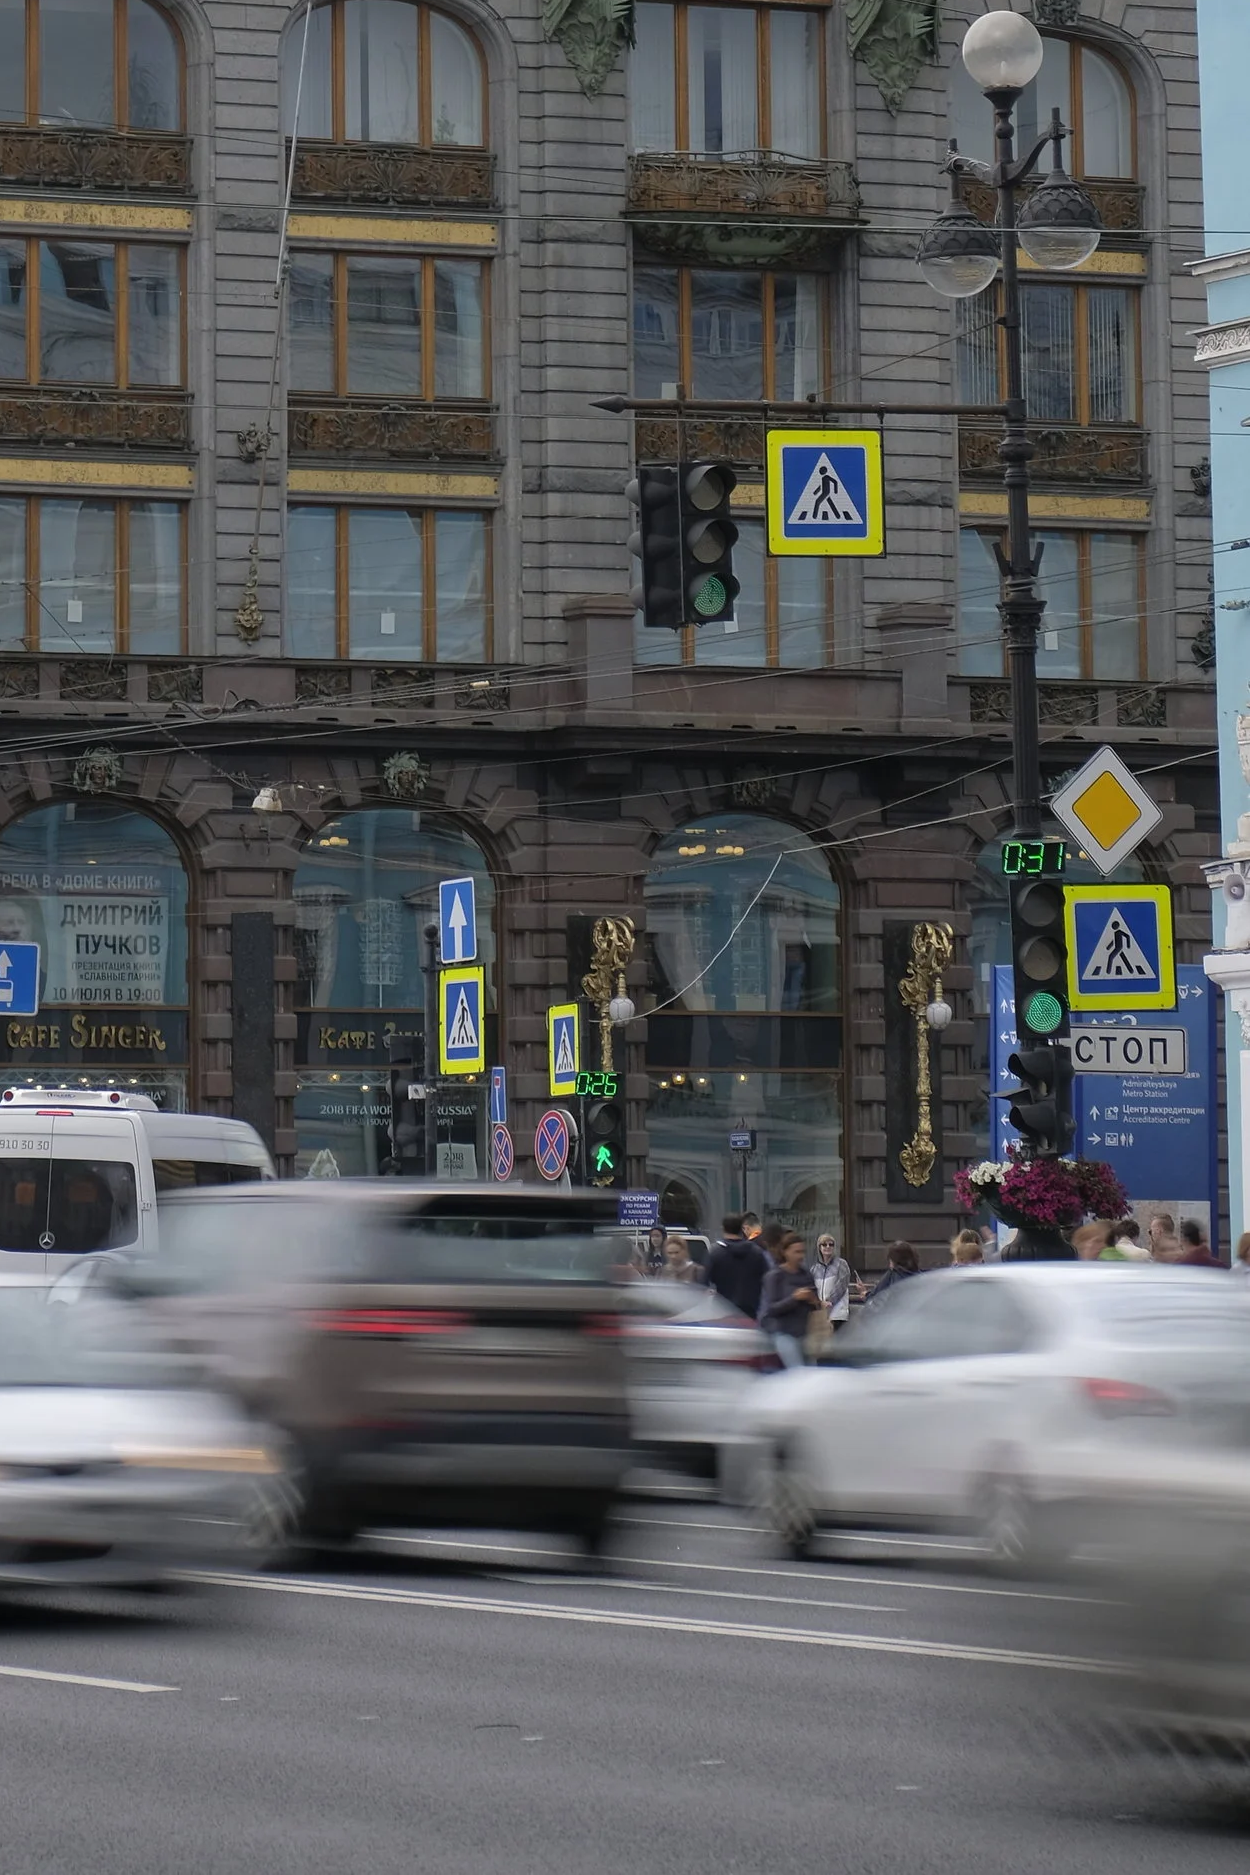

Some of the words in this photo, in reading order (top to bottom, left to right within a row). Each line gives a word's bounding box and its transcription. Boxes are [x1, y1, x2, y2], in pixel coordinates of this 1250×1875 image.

[1003, 842, 1064, 874] 0:31
[42, 874, 51, 889] В
[55, 874, 104, 891] «ДОМЕ
[107, 874, 162, 889] КНИГИ»
[60, 900, 162, 928] ДМИТРИЙ
[75, 934, 161, 956] ПУЧКОВ
[71, 961, 131, 971] ПРЕЗЕНТАЦИЯ
[79, 972, 126, 981] «СЛАВНЫЕ
[52, 988, 67, 1001] 10
[71, 988, 111, 1001] ИЮЛЯ
[115, 988, 123, 1001] В
[126, 988, 161, 1001] 19:00
[7, 1022, 61, 1049] CAFE
[70, 1014, 166, 1051] SINGER
[1075, 1035, 1168, 1065] СТОП
[576, 1073, 618, 1095] 0:26
[1122, 1079, 1178, 1090] Admiralteyskaya
[1122, 1090, 1144, 1098] Metro
[1144, 1090, 1169, 1098] Station
[320, 1105, 344, 1115] 2018
[346, 1105, 368, 1115] FIFA
[1122, 1105, 1149, 1116] Центр
[1149, 1107, 1206, 1116] аккредитации
[1122, 1116, 1168, 1124] Accreditation
[1168, 1116, 1191, 1124] Centre
[0, 1139, 19, 1150] 910
[21, 1139, 34, 1150] 30
[36, 1140, 50, 1151] 30
